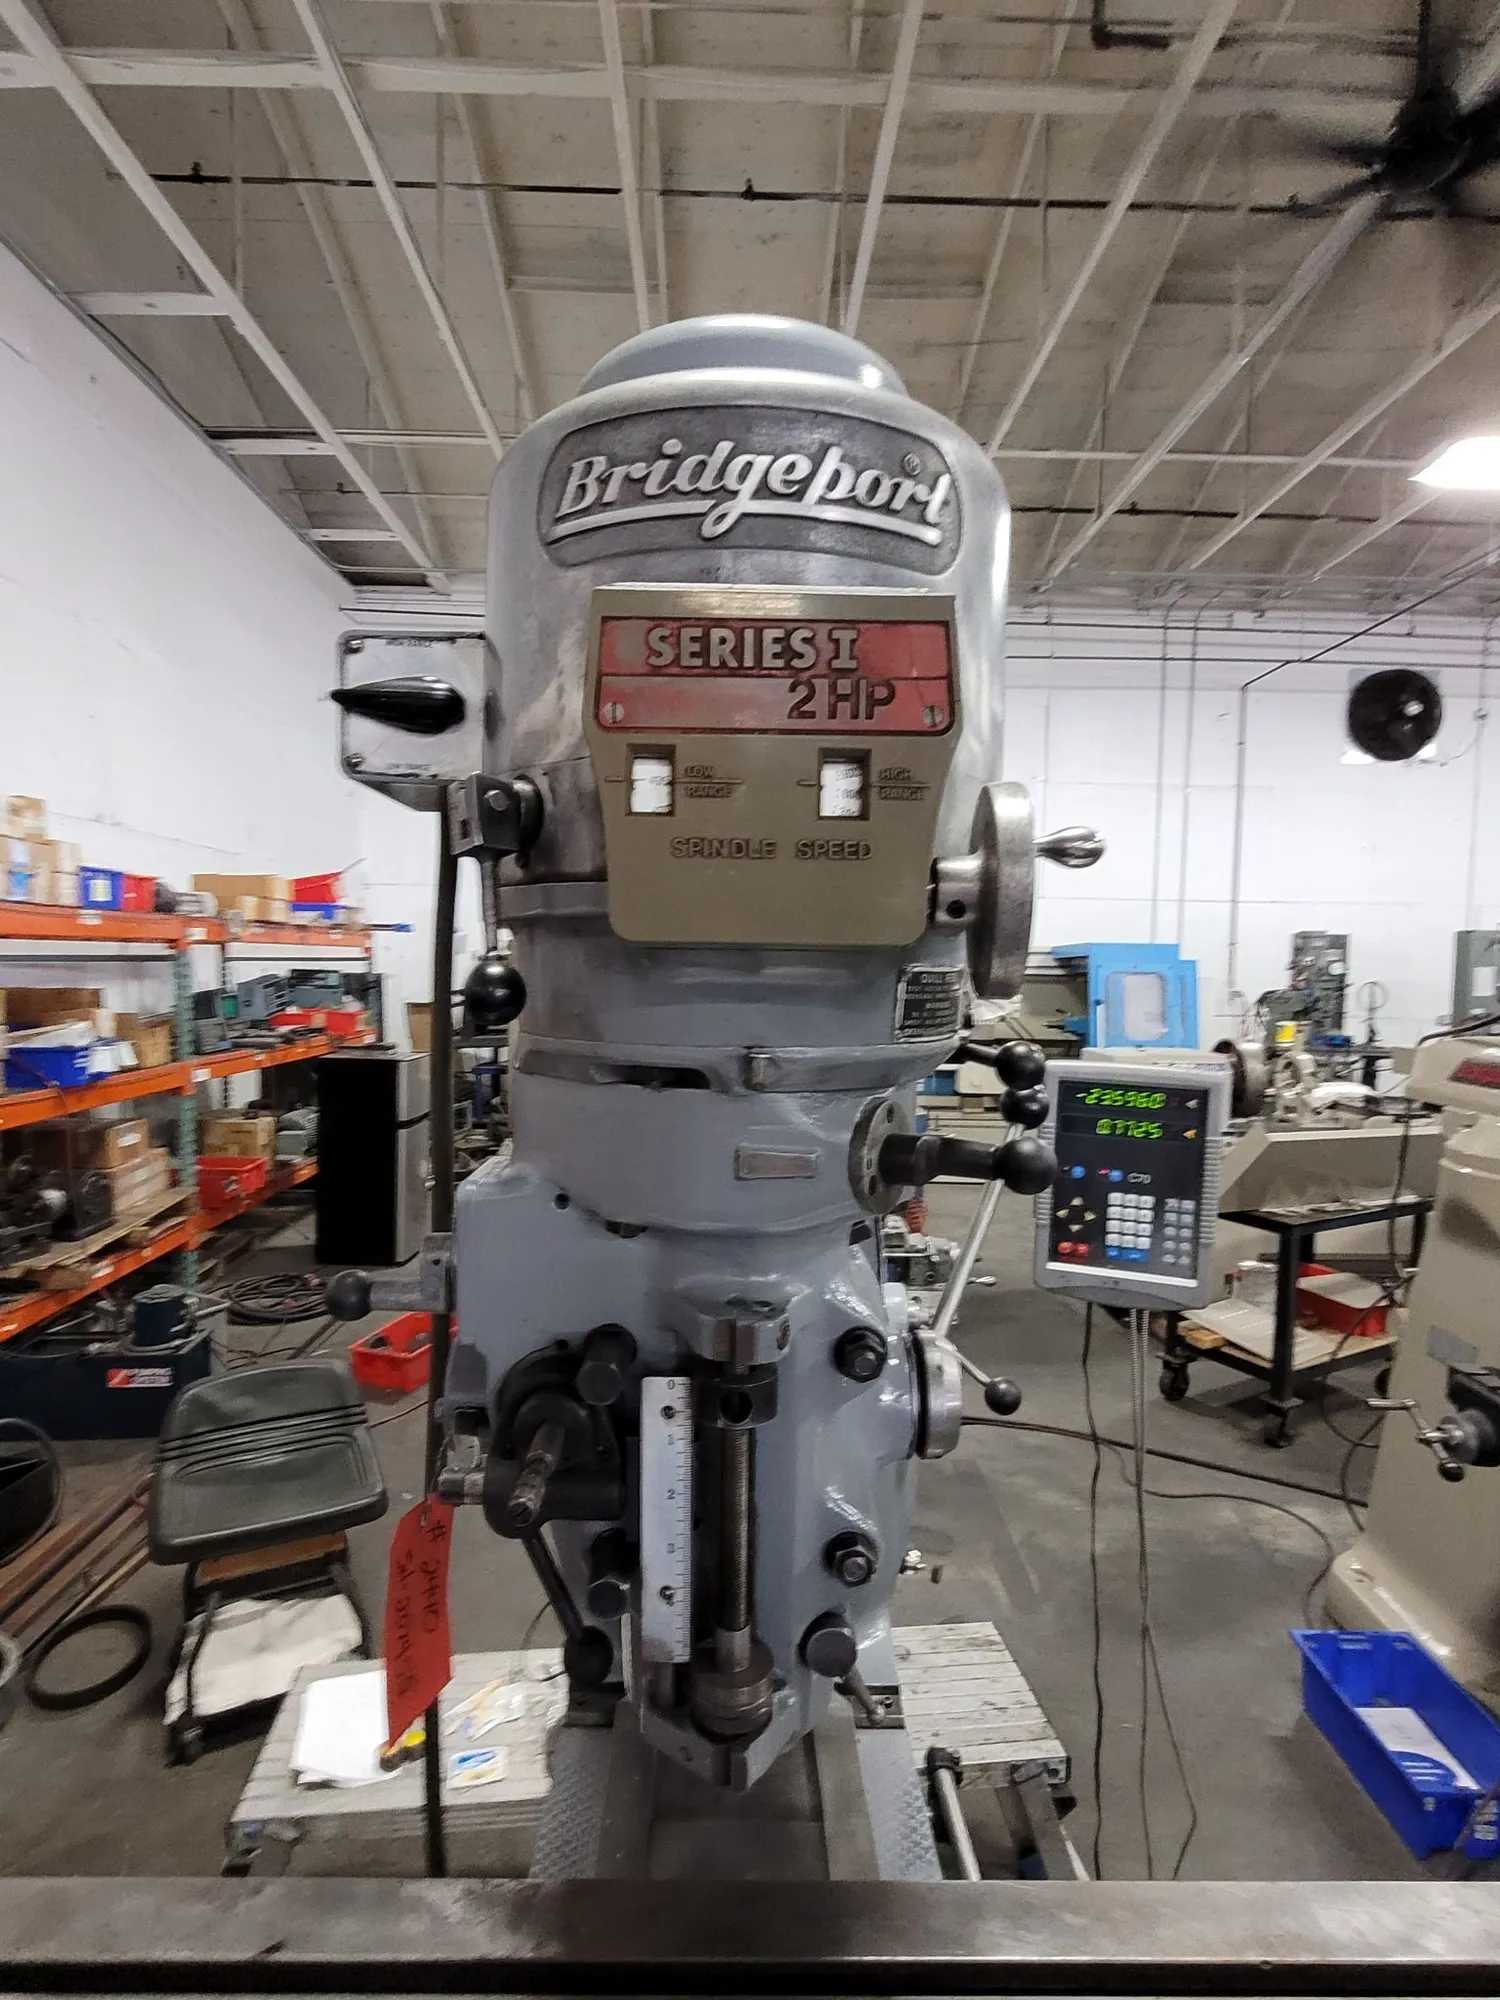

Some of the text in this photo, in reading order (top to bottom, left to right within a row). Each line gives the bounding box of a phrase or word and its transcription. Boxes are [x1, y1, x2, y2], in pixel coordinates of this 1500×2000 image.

[555, 437, 951, 539] Bridgeport
[646, 626, 859, 670] SERIES I
[684, 765, 714, 778] LOW
[878, 768, 912, 781] HIGH
[686, 785, 732, 799] RANGE
[671, 837, 873, 861] SPINDLE SPEED
[666, 1380, 676, 1390] 0
[666, 1488, 676, 1500] 2
